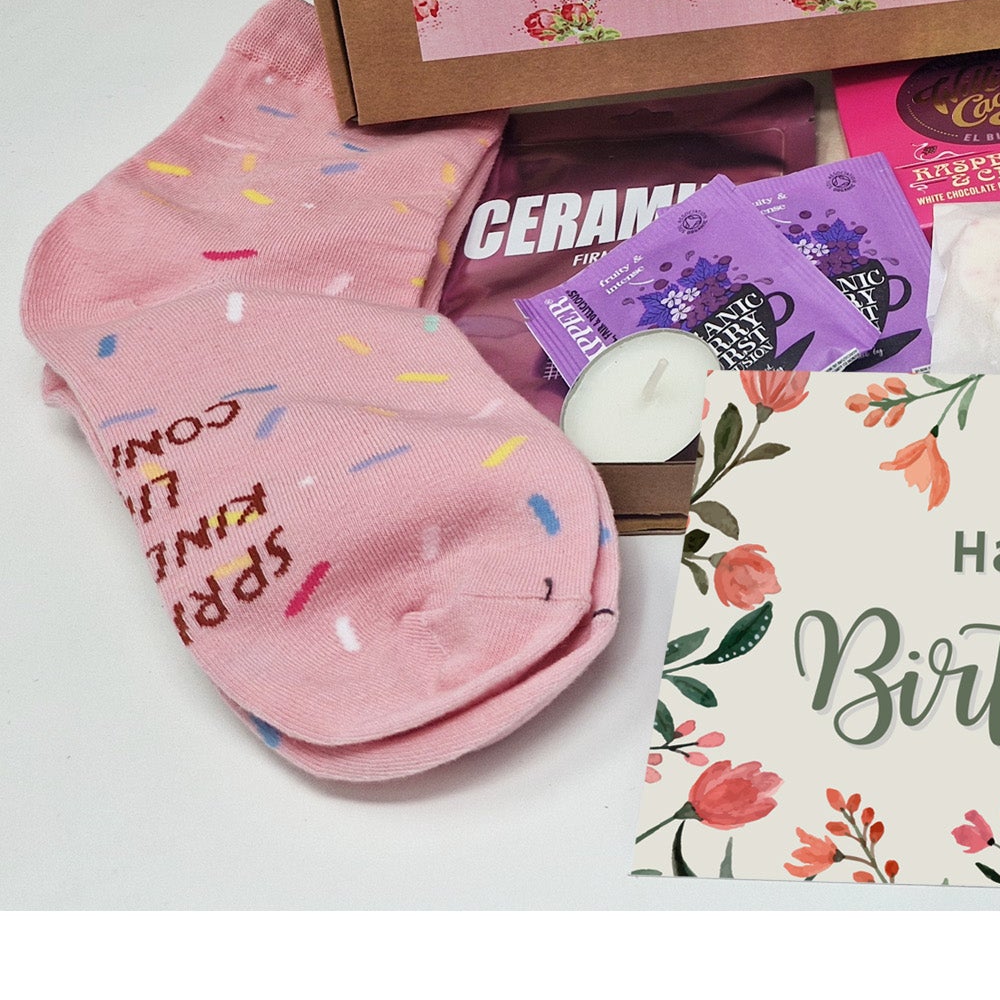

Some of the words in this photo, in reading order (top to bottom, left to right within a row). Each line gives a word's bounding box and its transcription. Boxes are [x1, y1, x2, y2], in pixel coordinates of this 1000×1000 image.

[963, 133, 980, 142] EL
[951, 173, 970, 187] &
[916, 193, 946, 206] WHITE
[946, 184, 997, 201] CHOCOLATE
[599, 263, 630, 288] fruity
[605, 265, 646, 295] intense
[700, 293, 764, 342] ANIC
[597, 323, 613, 340] FAIR
